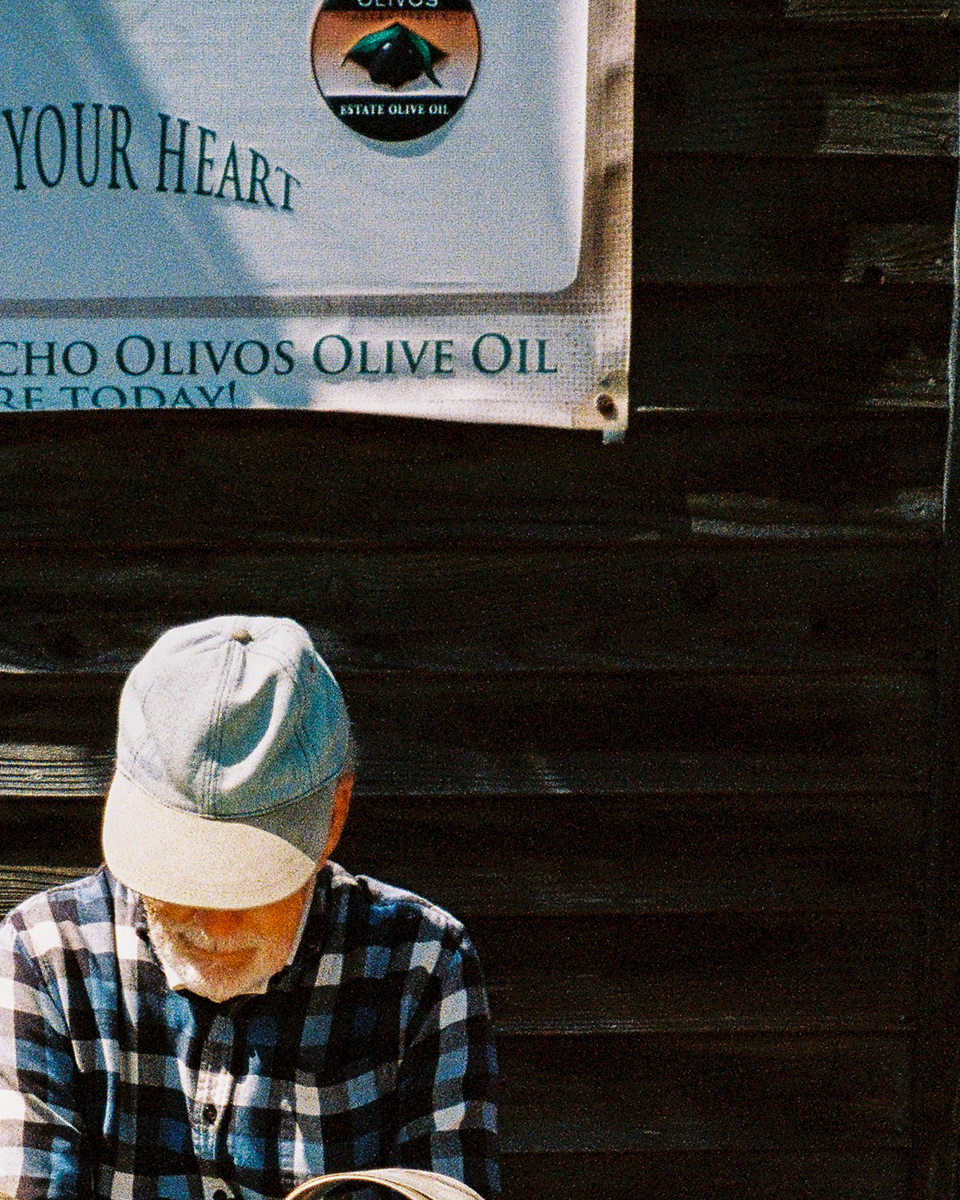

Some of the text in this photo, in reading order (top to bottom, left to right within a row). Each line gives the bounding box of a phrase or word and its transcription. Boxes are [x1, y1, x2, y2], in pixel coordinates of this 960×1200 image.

[340, 103, 450, 116] ESTATE OLIVE OIL
[1, 102, 140, 191] YOUR
[155, 112, 302, 212] HEART
[114, 334, 296, 377] OLIVOS
[312, 332, 455, 377] OLIVE
[471, 331, 559, 376] OIL
